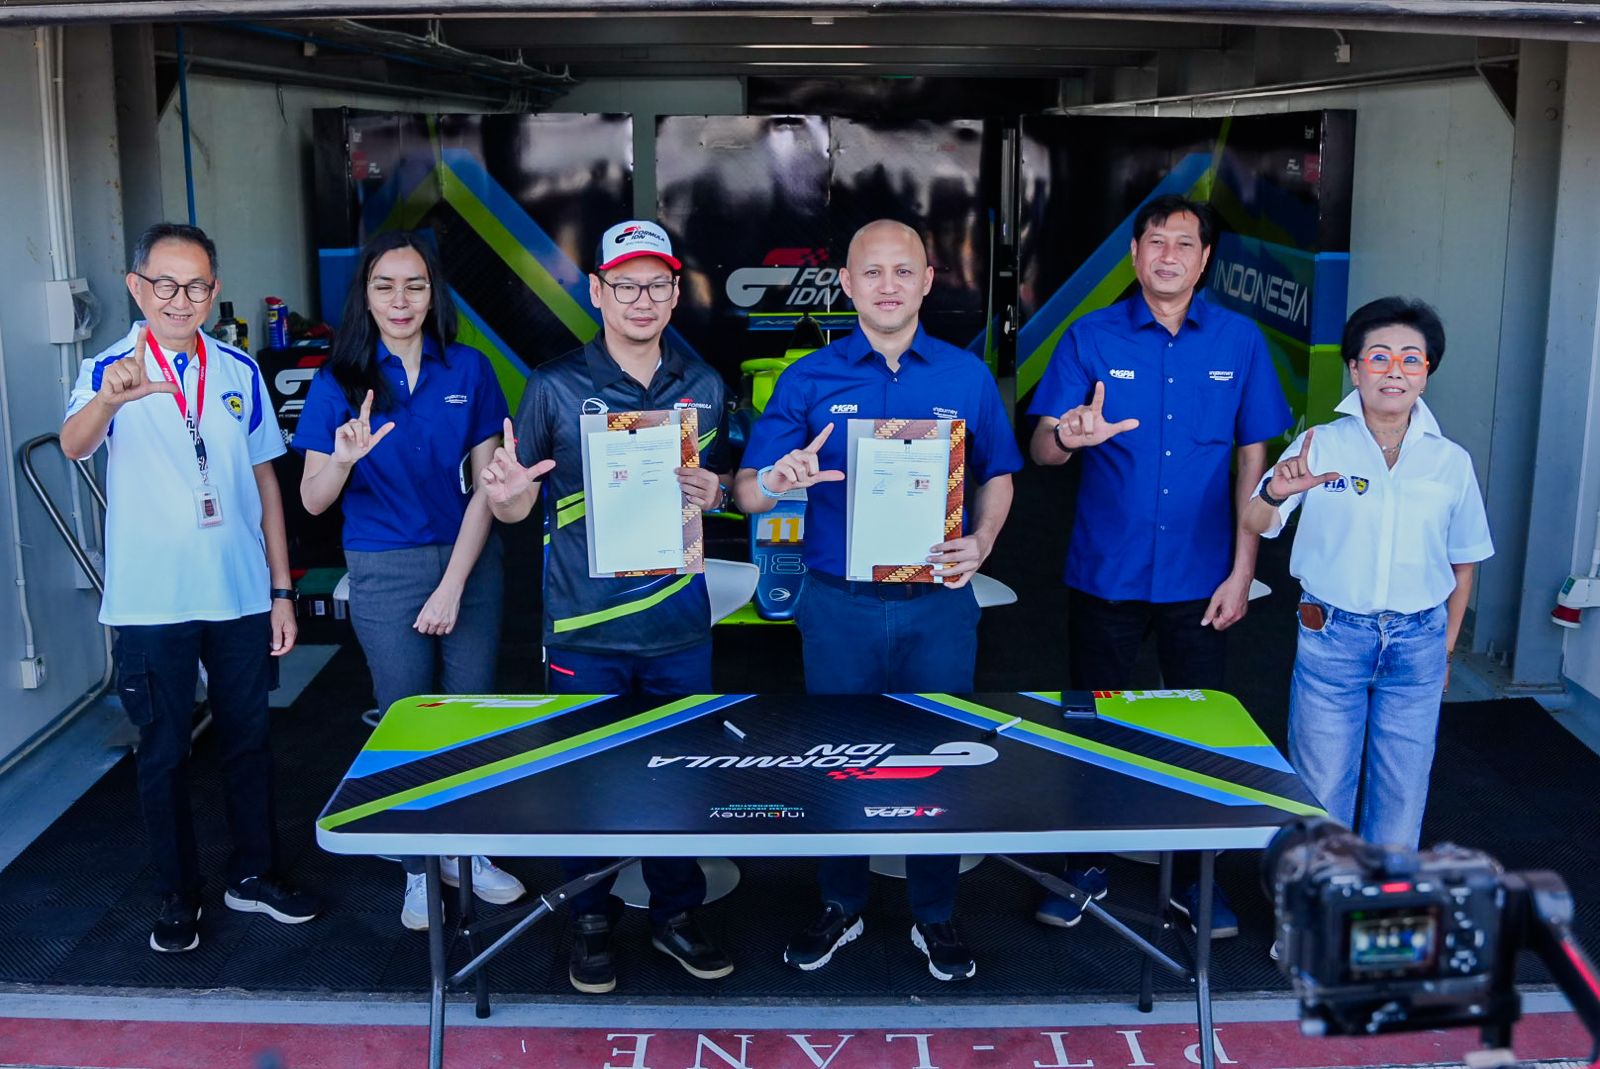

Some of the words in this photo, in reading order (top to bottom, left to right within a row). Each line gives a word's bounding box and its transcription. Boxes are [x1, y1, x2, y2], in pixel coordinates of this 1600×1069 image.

[633, 230, 665, 242] FORMULA
[785, 287, 842, 305] IDN
[1212, 259, 1309, 327] INDONESIA
[767, 517, 800, 543] 11
[804, 743, 896, 755] IDN
[647, 755, 879, 768] FORMULA
[709, 810, 805, 818] injourney
[864, 806, 945, 818] MGPA
